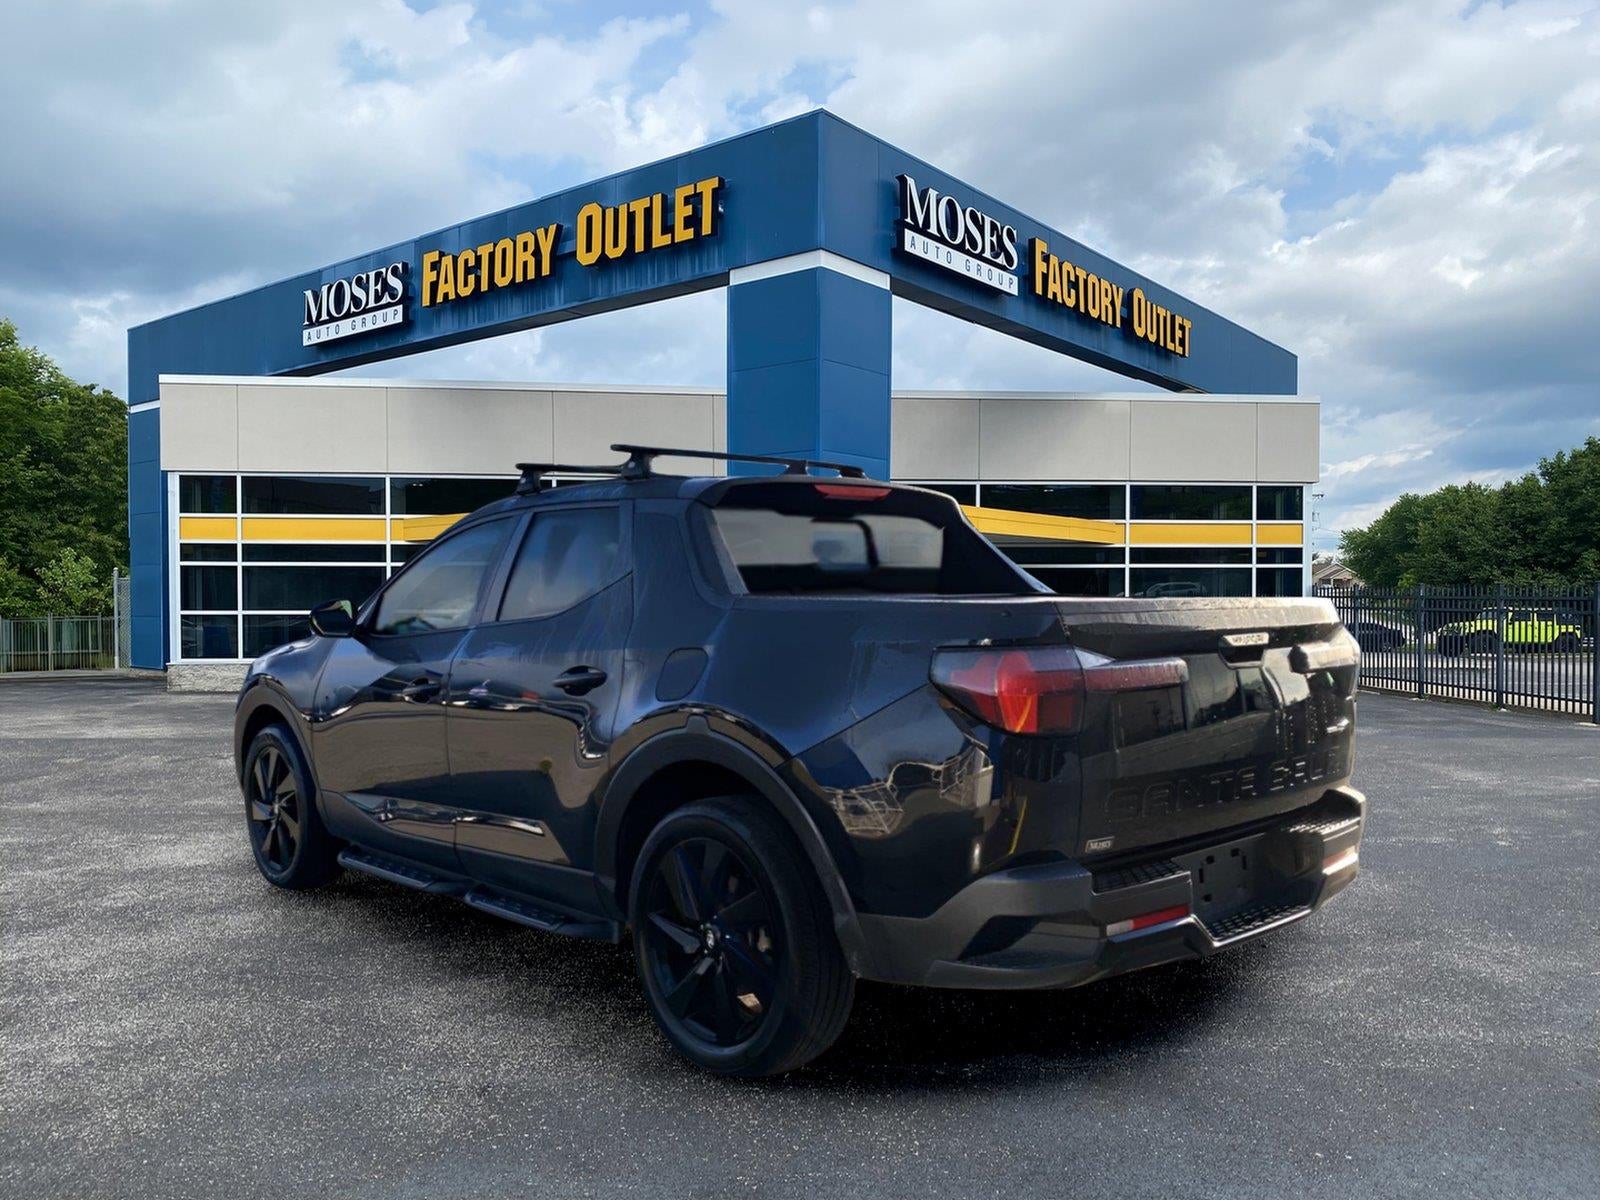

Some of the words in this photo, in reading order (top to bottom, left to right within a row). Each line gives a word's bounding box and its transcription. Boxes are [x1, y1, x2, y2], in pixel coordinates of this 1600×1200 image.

[423, 224, 558, 307] FACTORY
[576, 176, 720, 265] OUTLET
[904, 175, 1018, 270] MOSES
[910, 235, 952, 264] AUTO
[965, 259, 1014, 289] GROUP
[303, 262, 404, 326] MOSES
[307, 324, 340, 342] AUTO
[351, 309, 399, 331] GROUP
[1034, 238, 1124, 328] FACTORY
[1132, 288, 1192, 357] OUTLET
